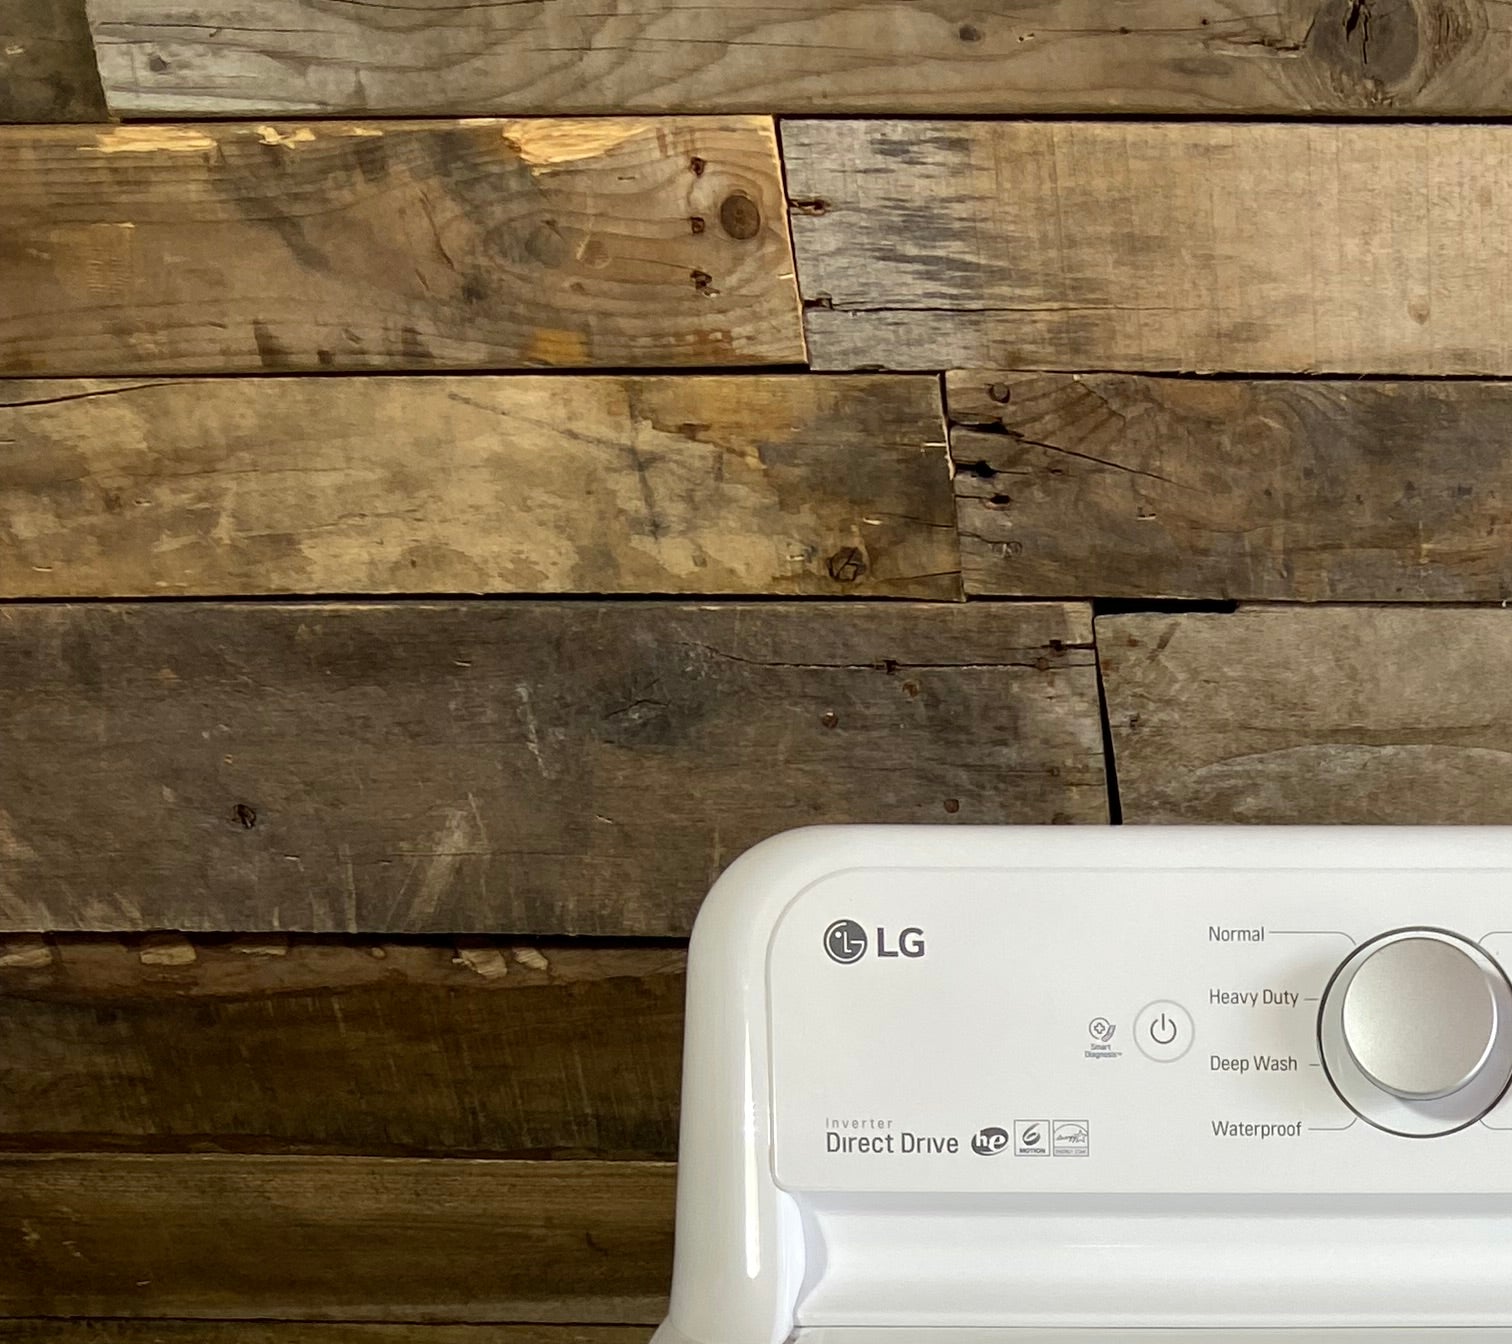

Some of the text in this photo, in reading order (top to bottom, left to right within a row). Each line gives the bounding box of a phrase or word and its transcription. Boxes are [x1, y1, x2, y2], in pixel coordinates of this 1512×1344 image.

[877, 927, 925, 958] LG
[1208, 926, 1265, 942] Normal
[1209, 989, 1299, 1006] Heavy Duty
[1210, 1056, 1298, 1073] Deep Wash
[826, 1117, 893, 1129] Inverter
[1211, 1120, 1302, 1139] Waterproof
[826, 1132, 894, 1154] Direct
[901, 1132, 959, 1154] Drive
